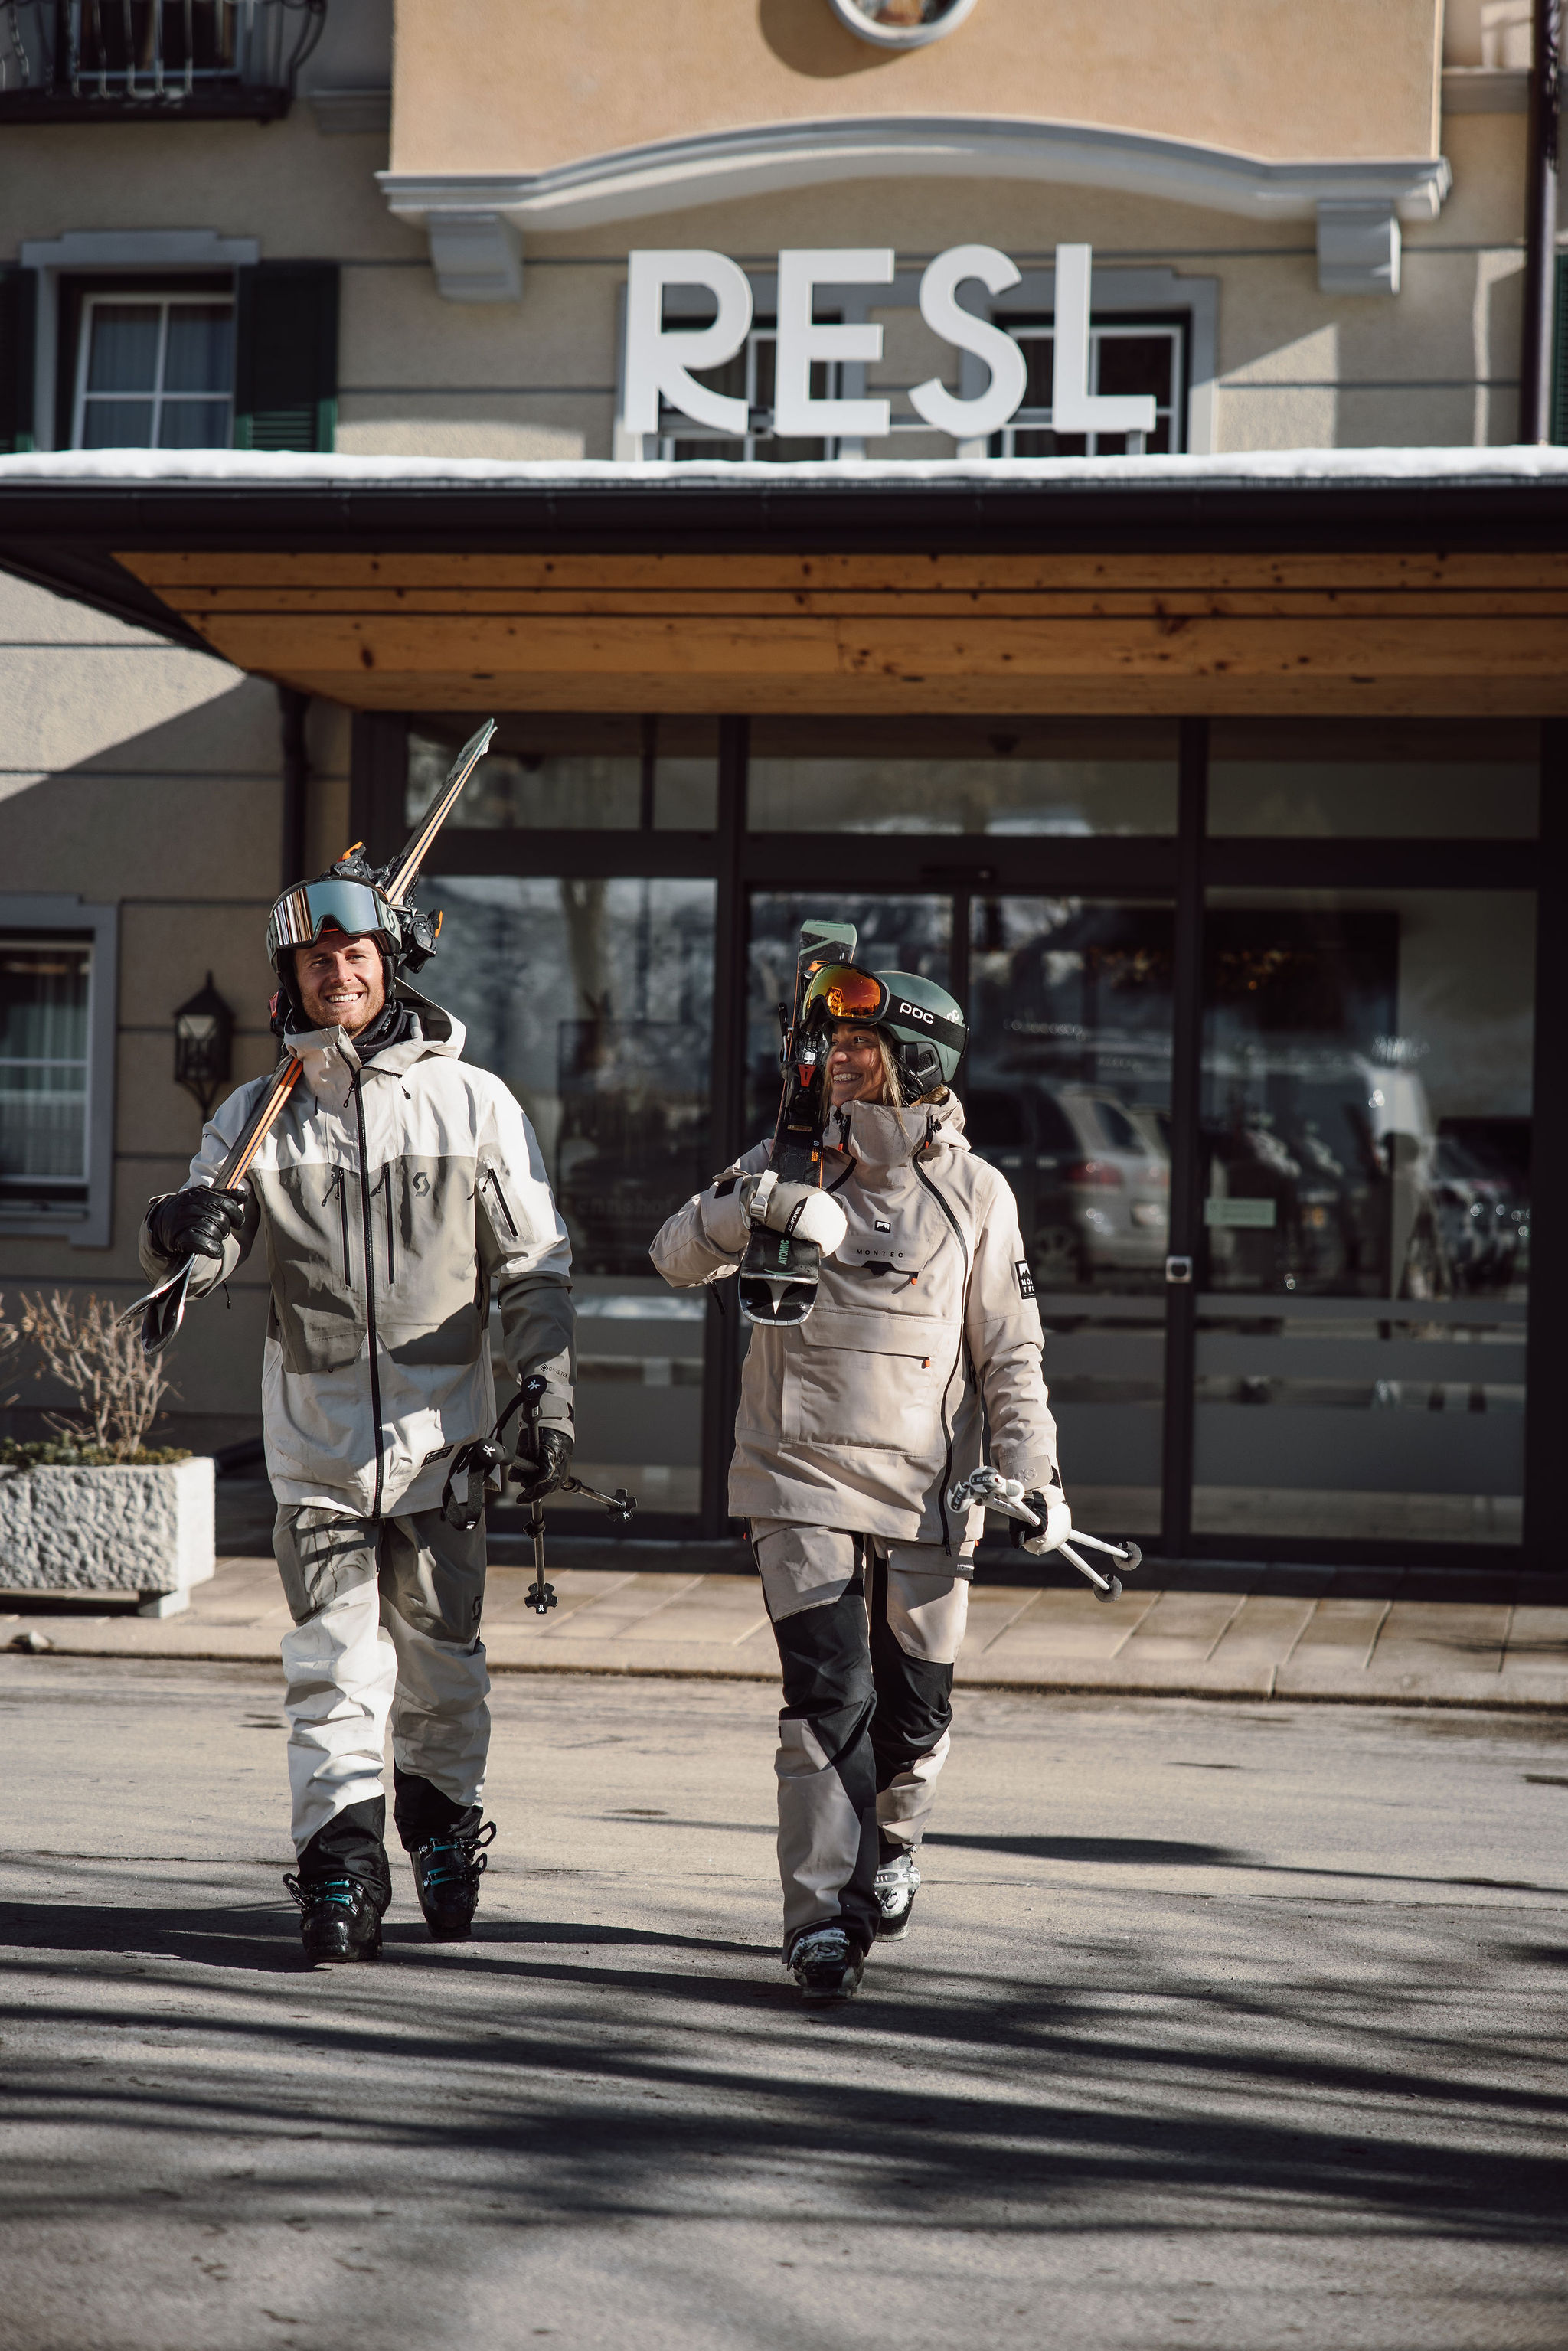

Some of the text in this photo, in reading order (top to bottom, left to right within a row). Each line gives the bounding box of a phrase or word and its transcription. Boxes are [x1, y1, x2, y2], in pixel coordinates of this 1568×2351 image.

[624, 243, 1157, 439] RESL
[942, 1008, 960, 1023] OC
[787, 1206, 802, 1233] DAKINE
[777, 1239, 791, 1266] ATOMIC
[856, 1249, 904, 1259] MONTEC
[1021, 1278, 1034, 1286] MO
